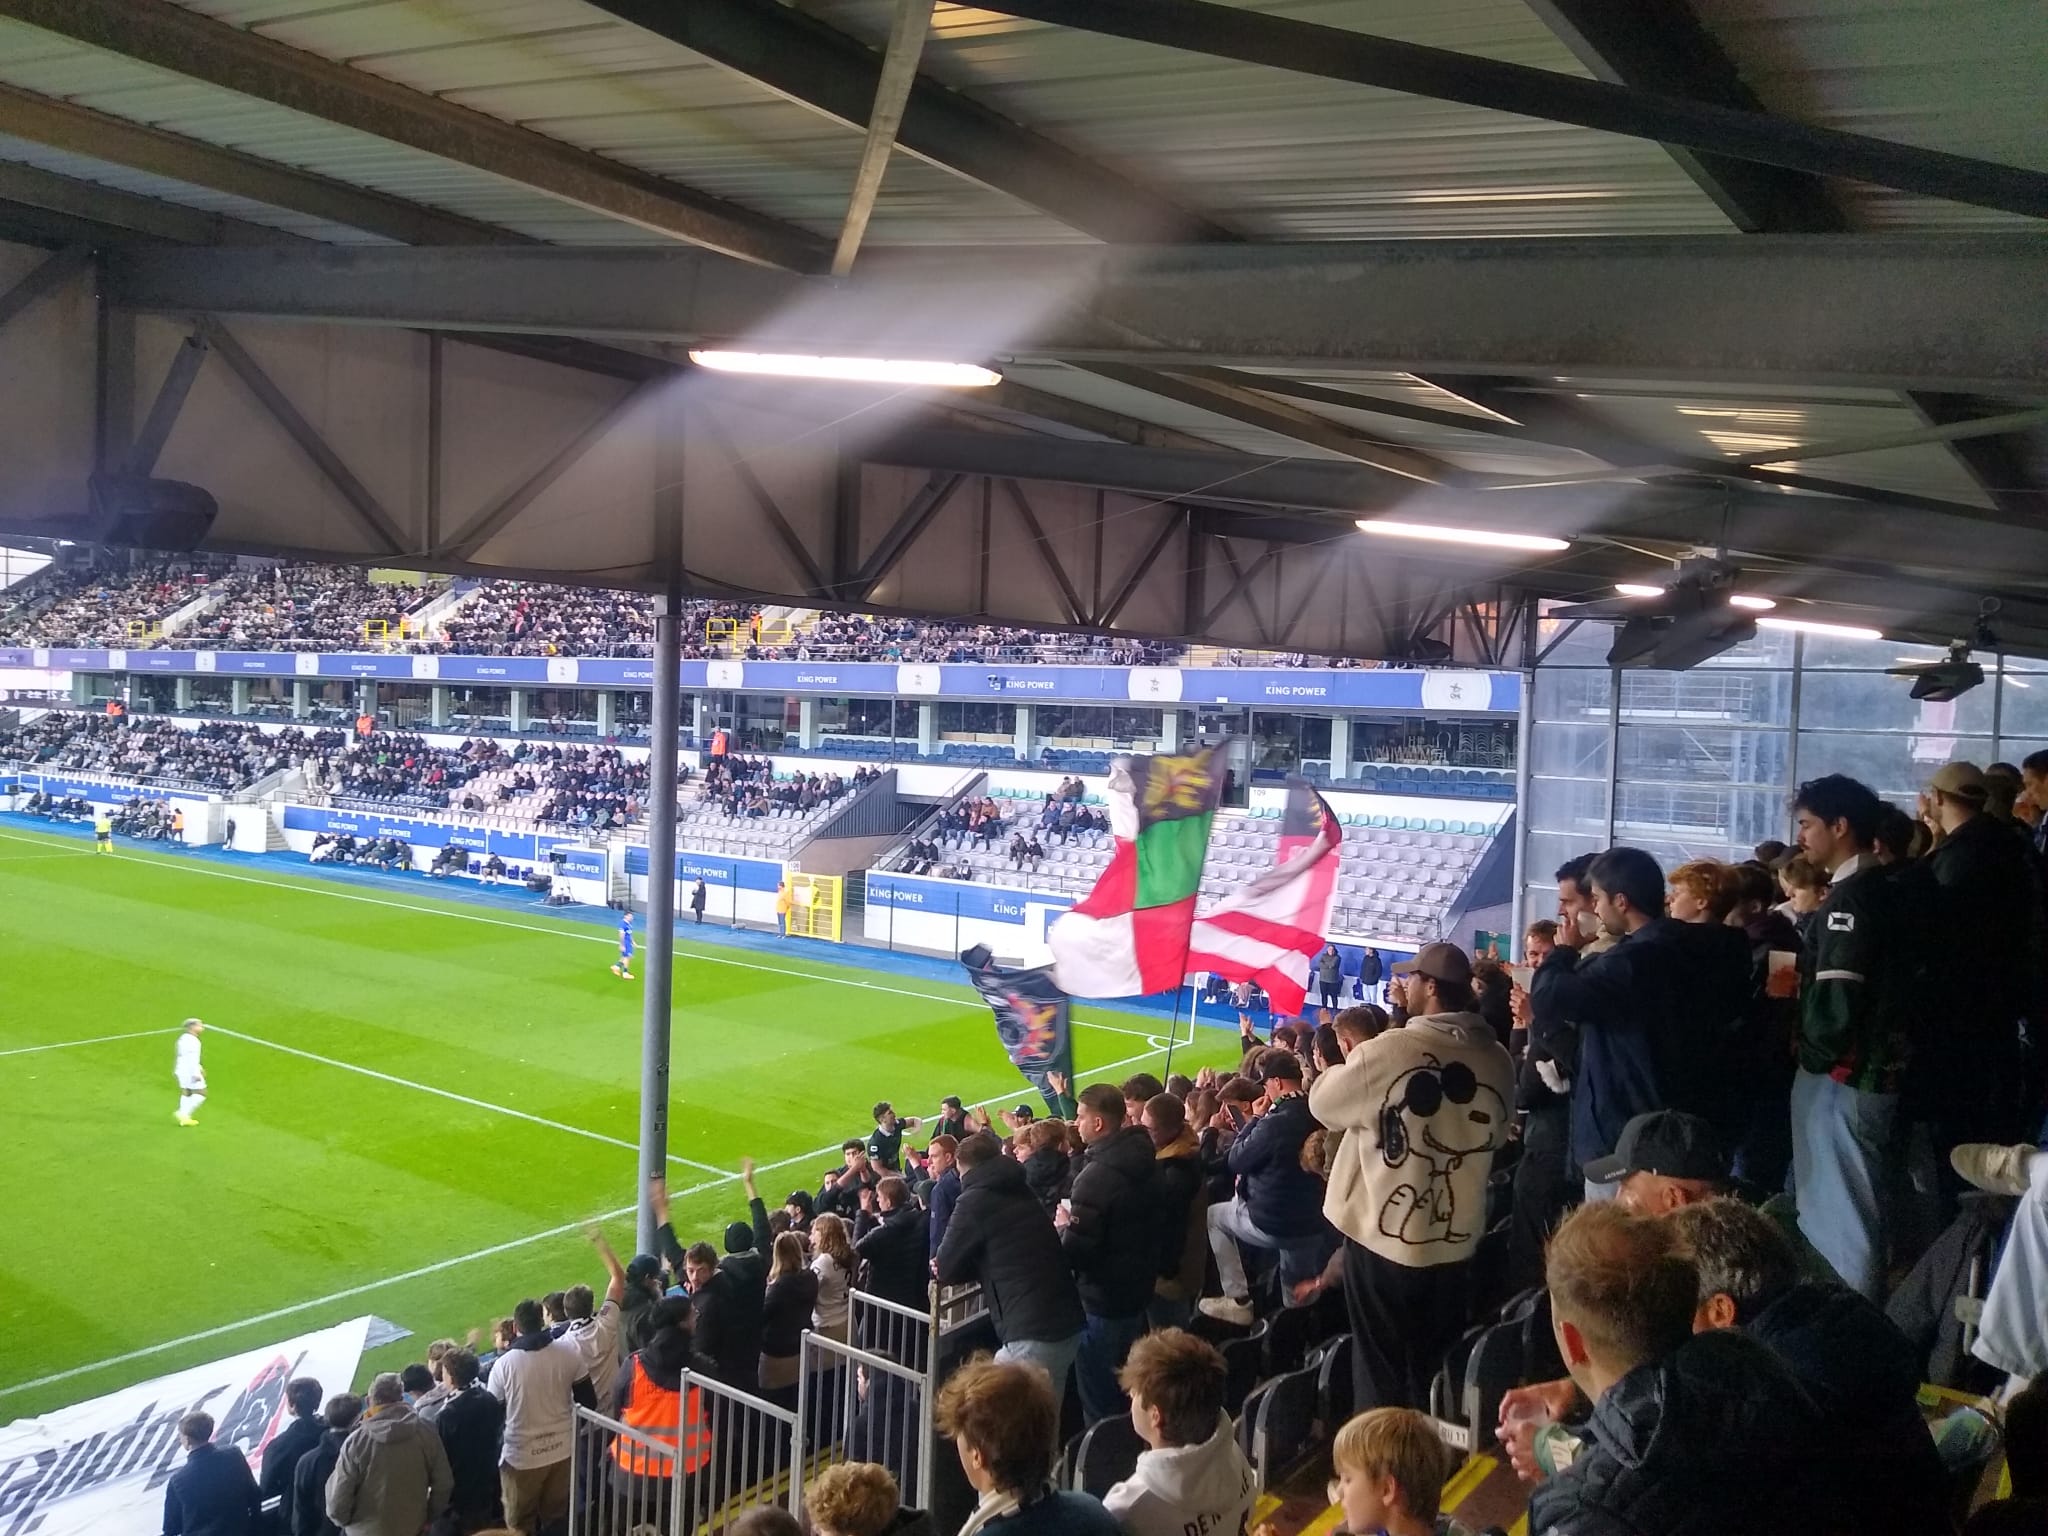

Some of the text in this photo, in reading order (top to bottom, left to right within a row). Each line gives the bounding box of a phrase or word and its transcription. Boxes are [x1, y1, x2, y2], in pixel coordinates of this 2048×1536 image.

[797, 675, 838, 684] KING POWER
[1006, 680, 1056, 690] KING POWER
[1265, 686, 1327, 697] KING POWER
[576, 864, 600, 874] POWER
[683, 865, 728, 879] KING POWER
[870, 887, 924, 904] KING POWER
[993, 903, 1018, 916] KING
